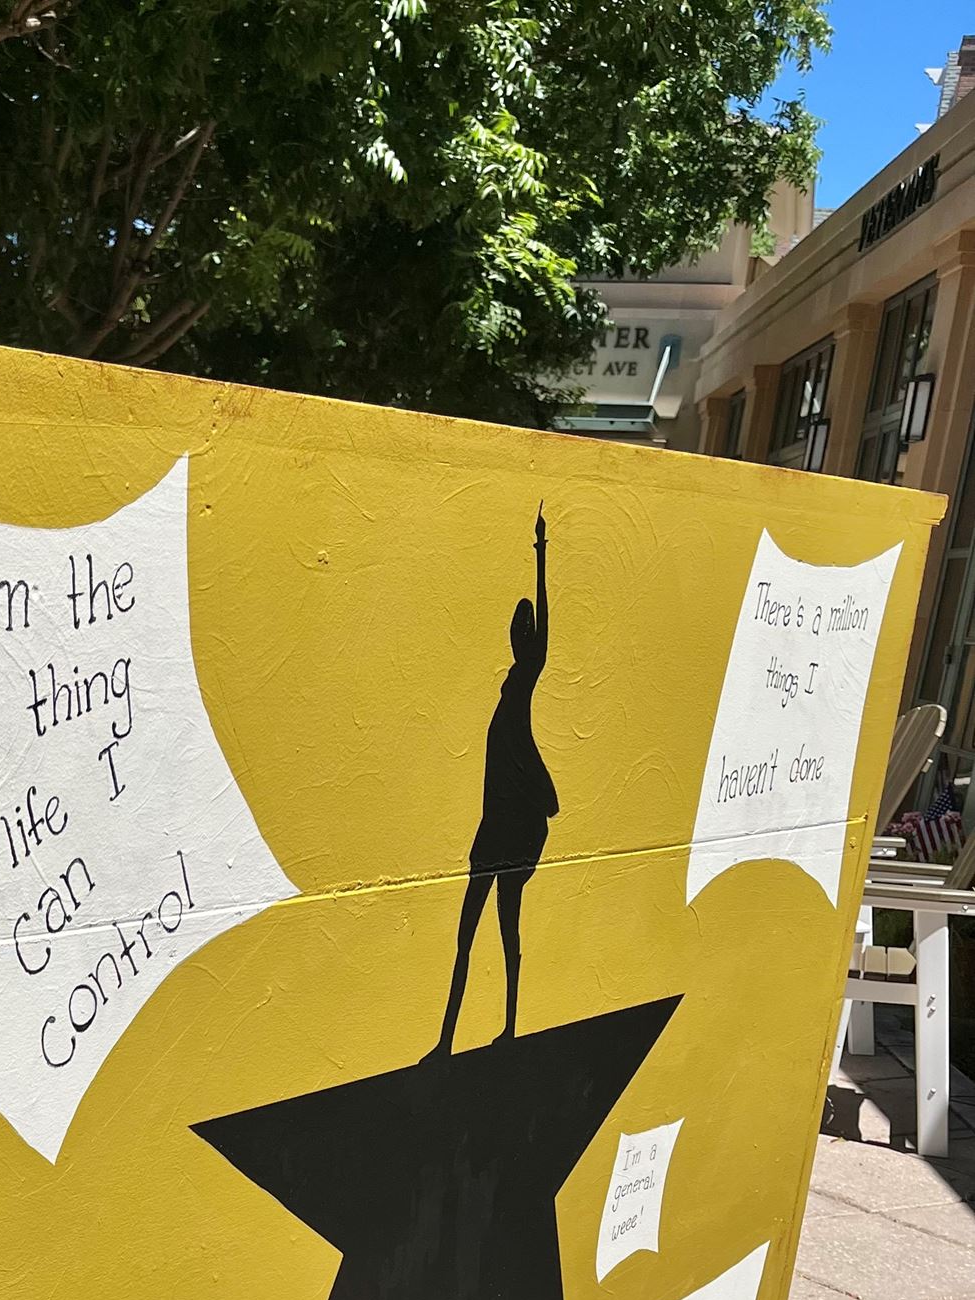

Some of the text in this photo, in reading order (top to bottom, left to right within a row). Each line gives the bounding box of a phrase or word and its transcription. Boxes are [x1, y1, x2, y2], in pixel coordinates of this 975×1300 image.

[603, 361, 638, 376] AVE
[67, 554, 136, 629] the
[754, 581, 869, 635] There's a million
[26, 656, 132, 738] thing
[766, 656, 819, 708] things I
[717, 743, 825, 803] haven't done
[0, 785, 69, 868] life
[98, 741, 126, 802] I
[622, 1143, 657, 1171] I'm a
[611, 1205, 644, 1241] weee!
